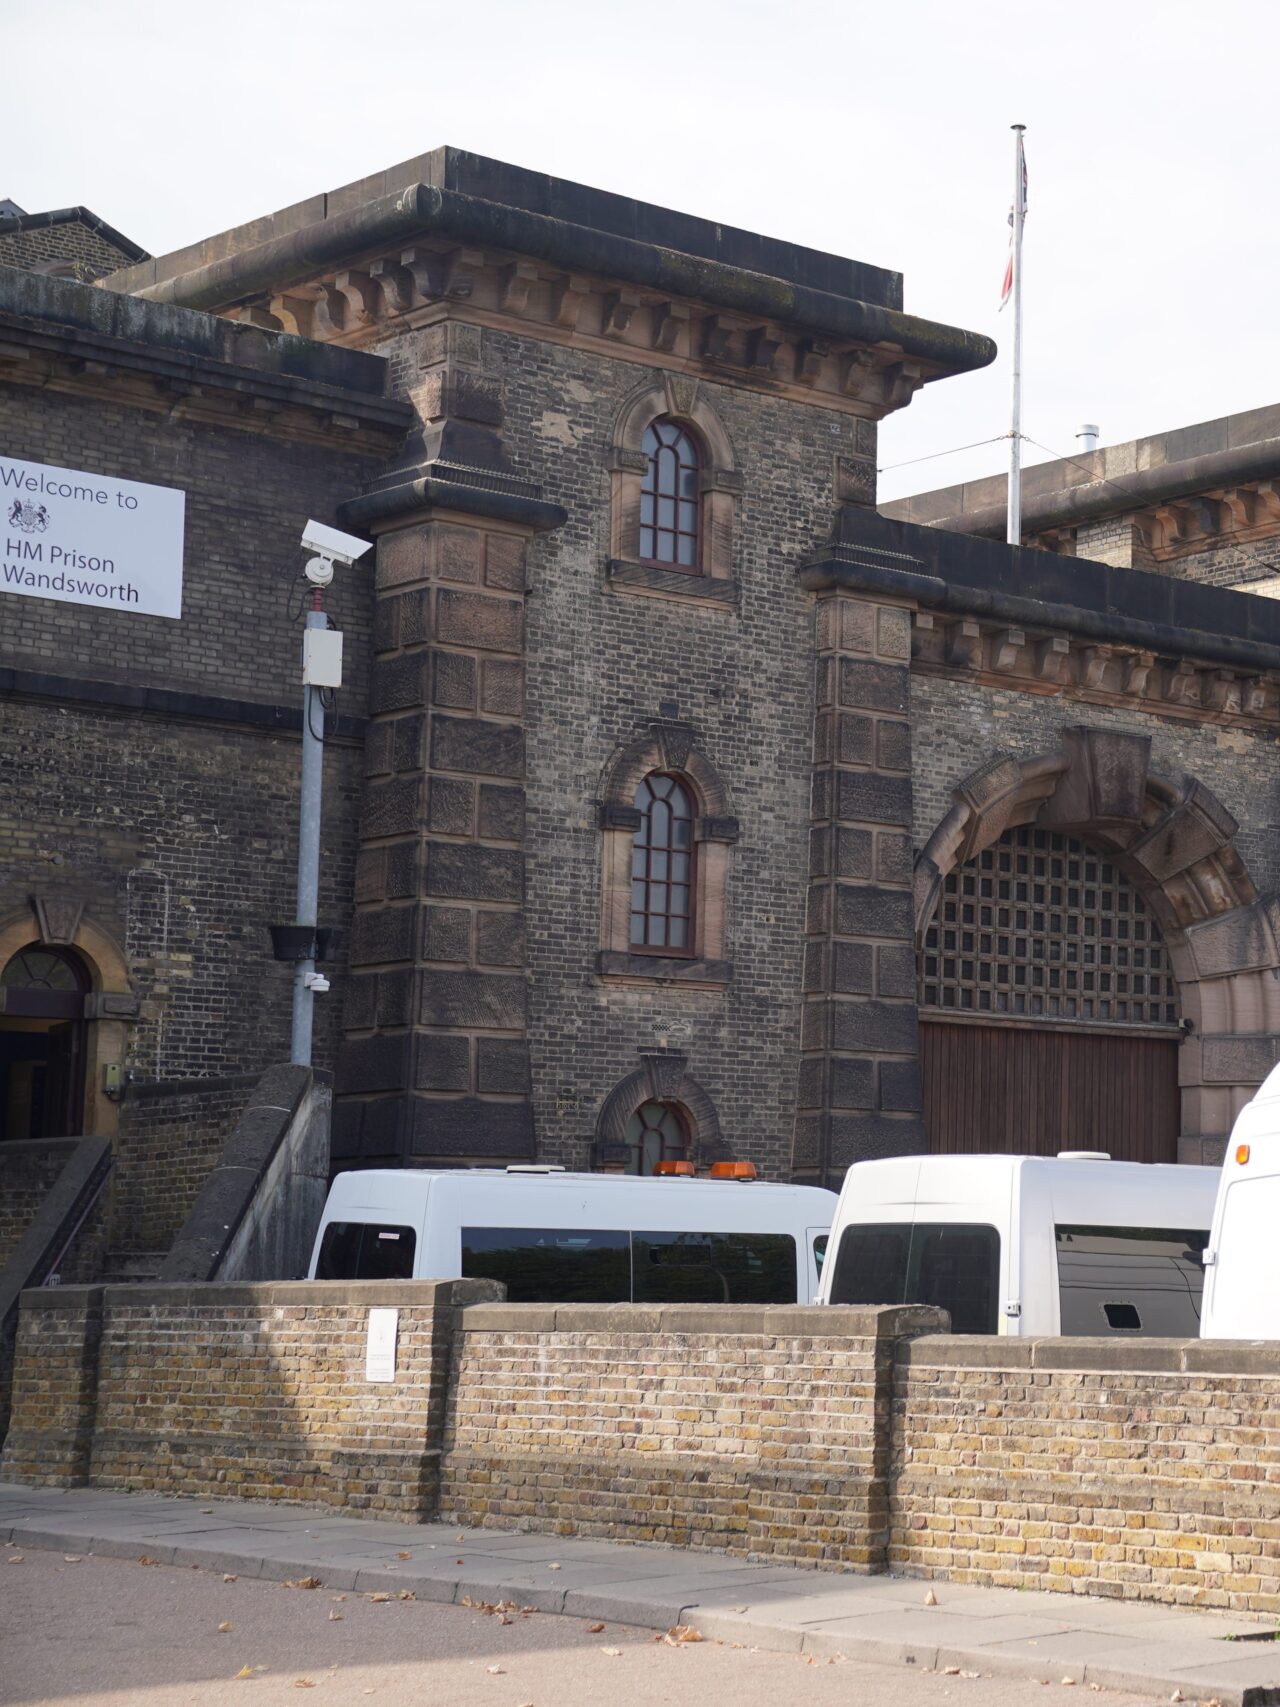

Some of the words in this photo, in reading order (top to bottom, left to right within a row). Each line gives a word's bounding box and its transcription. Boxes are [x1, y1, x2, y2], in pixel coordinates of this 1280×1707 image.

[0, 466, 108, 505] Welcome
[116, 491, 138, 509] to
[6, 538, 43, 562] HM
[50, 545, 115, 574] Prison
[3, 563, 139, 603] Wandsworth
